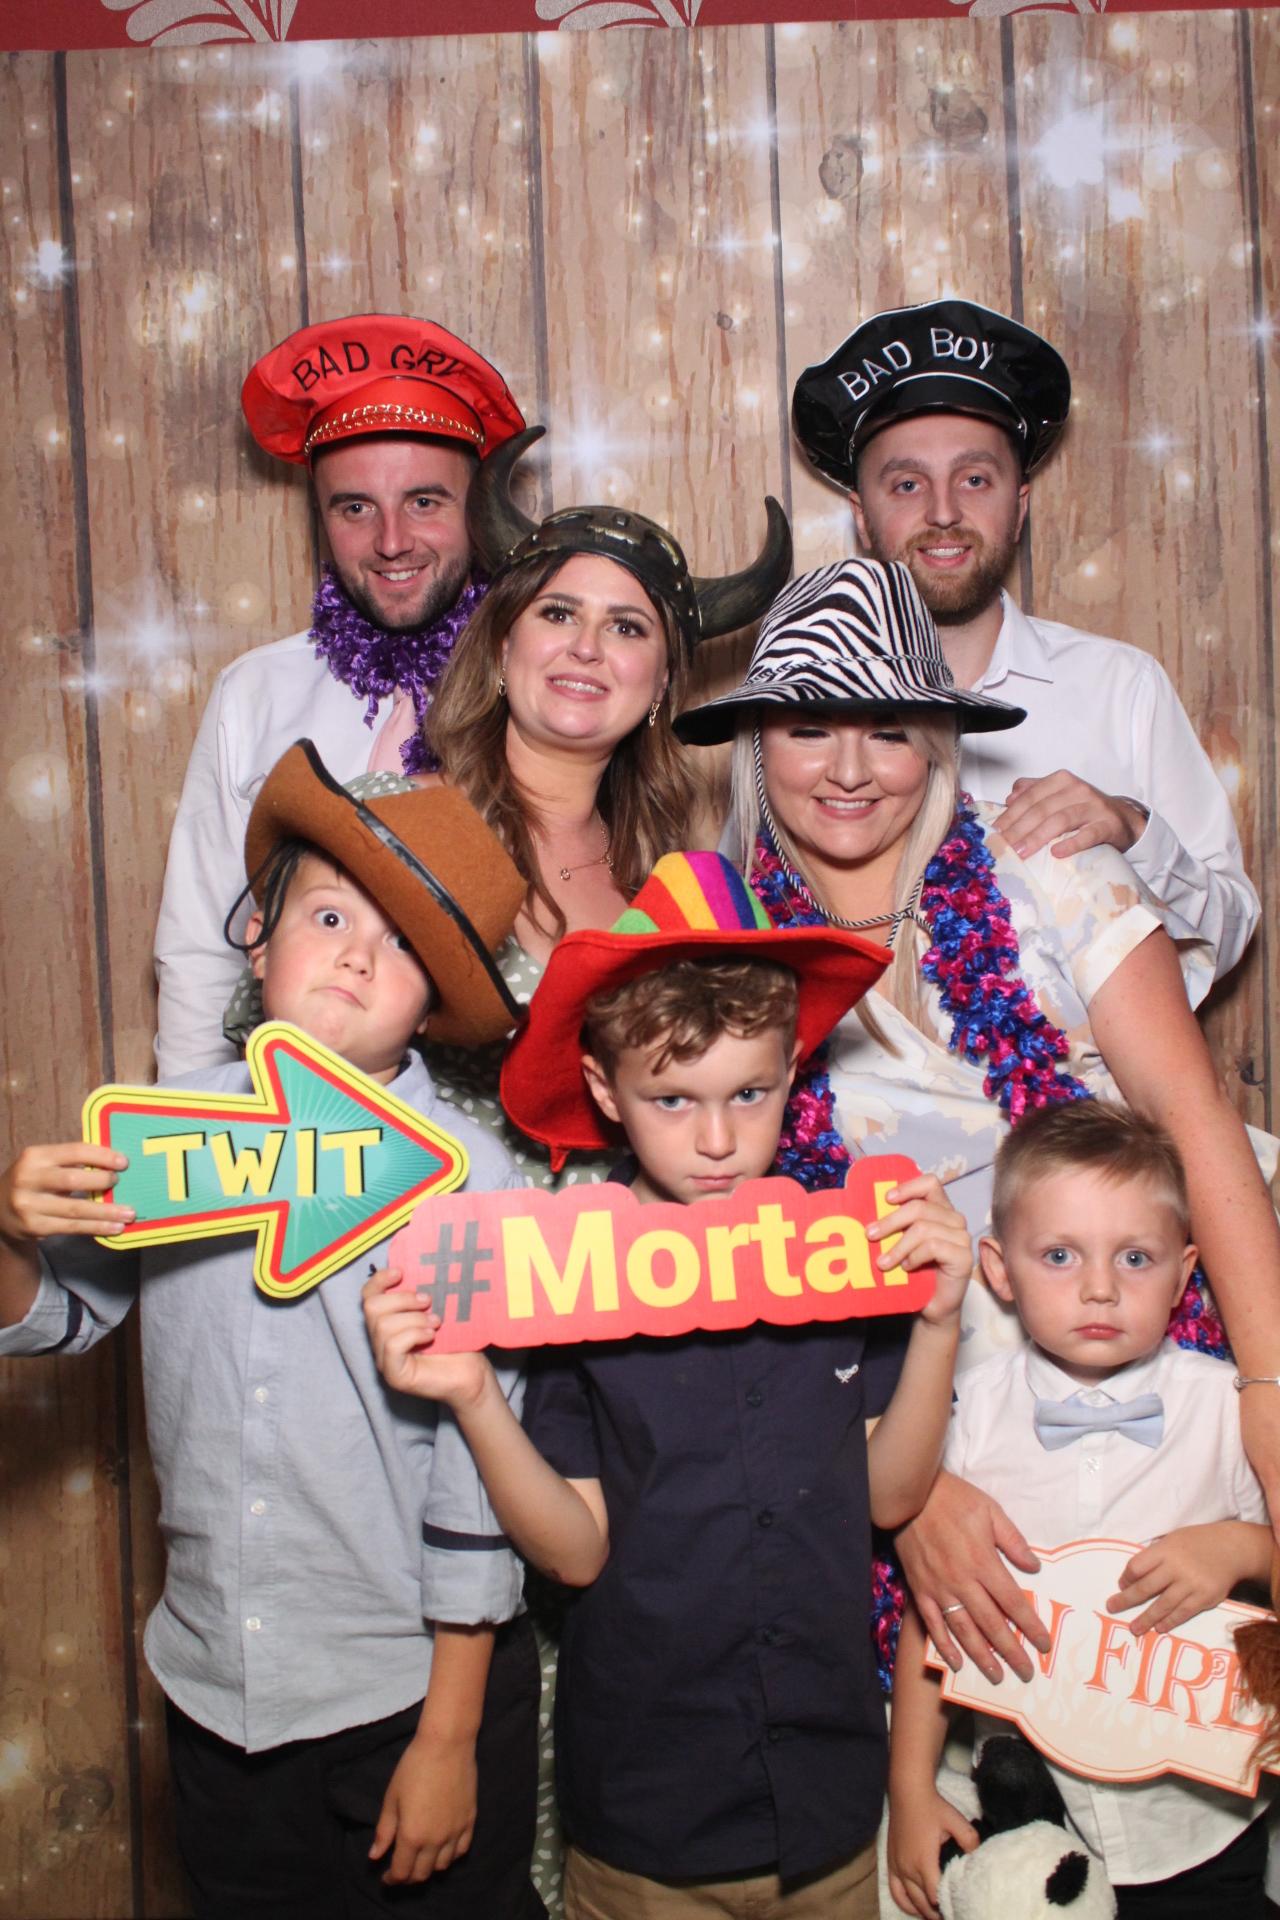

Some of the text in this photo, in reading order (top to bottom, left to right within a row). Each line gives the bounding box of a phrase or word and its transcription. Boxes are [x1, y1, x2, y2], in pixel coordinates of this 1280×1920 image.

[292, 341, 370, 392] BAD
[837, 327, 995, 401] BAD BOY
[142, 1127, 382, 1202] TWIT
